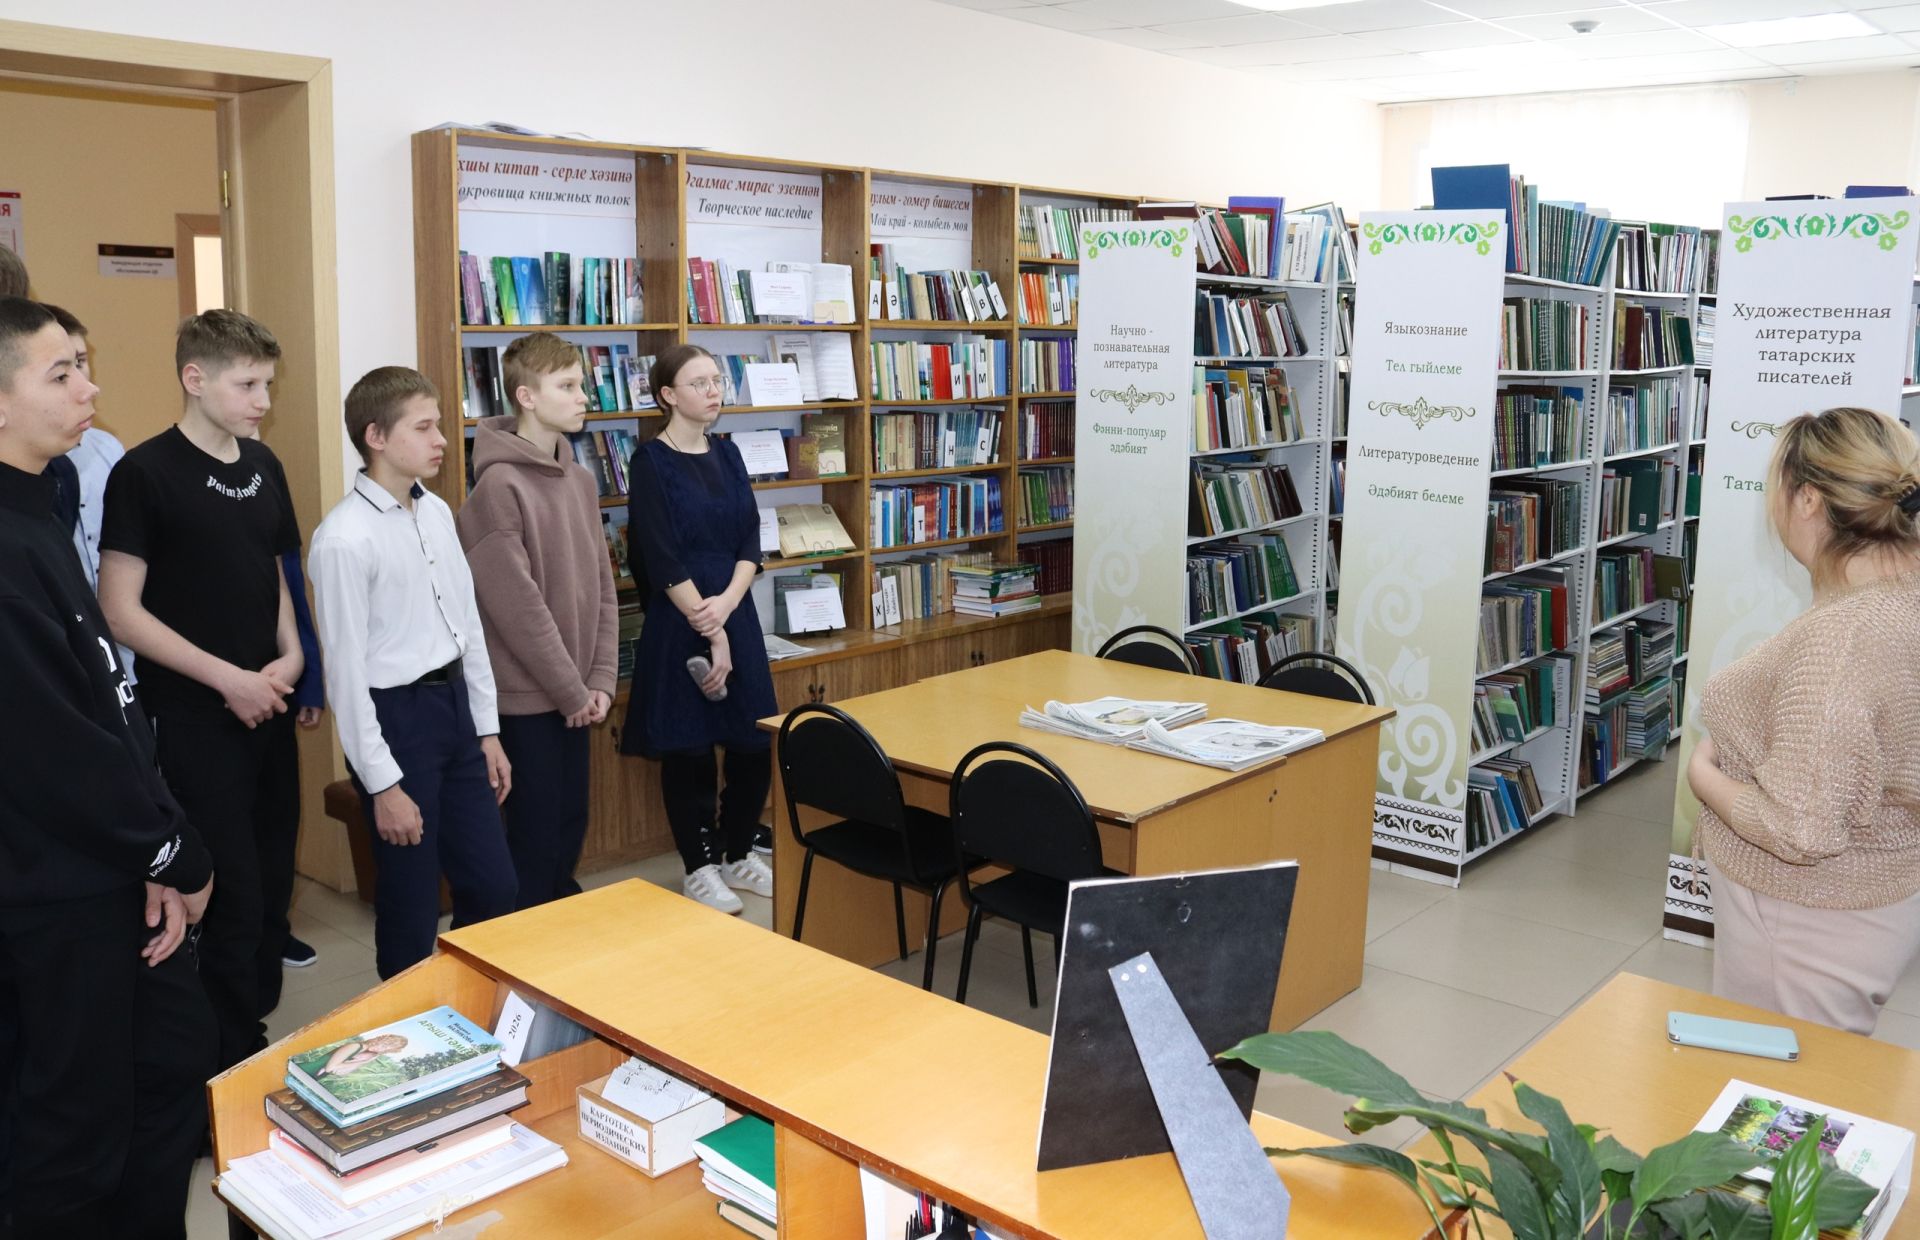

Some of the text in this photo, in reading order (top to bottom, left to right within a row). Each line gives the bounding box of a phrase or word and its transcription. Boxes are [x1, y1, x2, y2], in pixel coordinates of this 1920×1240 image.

[457, 160, 490, 173] хшы
[494, 162, 540, 177] китап
[551, 166, 587, 182] серле
[589, 169, 633, 183] хәзинә
[735, 179, 774, 196] мирас
[458, 186, 632, 206] окровища книжных полок
[902, 195, 930, 210] гомер
[932, 194, 970, 210] бишегем
[698, 198, 813, 220] Творческое наследие
[889, 215, 907, 230] край
[913, 217, 951, 230] колыбель
[952, 222, 968, 232] моя
[872, 293, 879, 305] А
[890, 294, 898, 306] Ә
[979, 298, 986, 310] В
[1052, 301, 1062, 312] Ш
[1732, 303, 1892, 321] Художественная
[1110, 324, 1147, 339] Научно
[1384, 321, 1468, 336] Языкознание
[1755, 328, 1862, 344] литература
[1093, 343, 1171, 353] познавательная
[1758, 350, 1856, 365] татарских
[1103, 360, 1158, 372] литература
[1385, 359, 1463, 375] Тел гыйлеме
[954, 374, 961, 385] И
[978, 372, 986, 384] М
[1757, 371, 1853, 386] писателей
[1092, 422, 1167, 440] Фәнни-популяр
[948, 444, 954, 456] Н
[979, 439, 986, 451] С
[1110, 442, 1148, 454] әдәбият
[1358, 445, 1480, 466] Литературоведение
[1723, 475, 1766, 492] Тата
[1368, 484, 1464, 505] Әдәбият белеме
[918, 519, 923, 531] Т
[876, 604, 882, 616] Х
[508, 1014, 522, 1039] 2026
[590, 1105, 635, 1137] КАРТОТЕКА
[581, 1111, 646, 1154] ПЕРИОДИЧЕСКИХ
[595, 1130, 631, 1156] ИЗДАНИЙ
